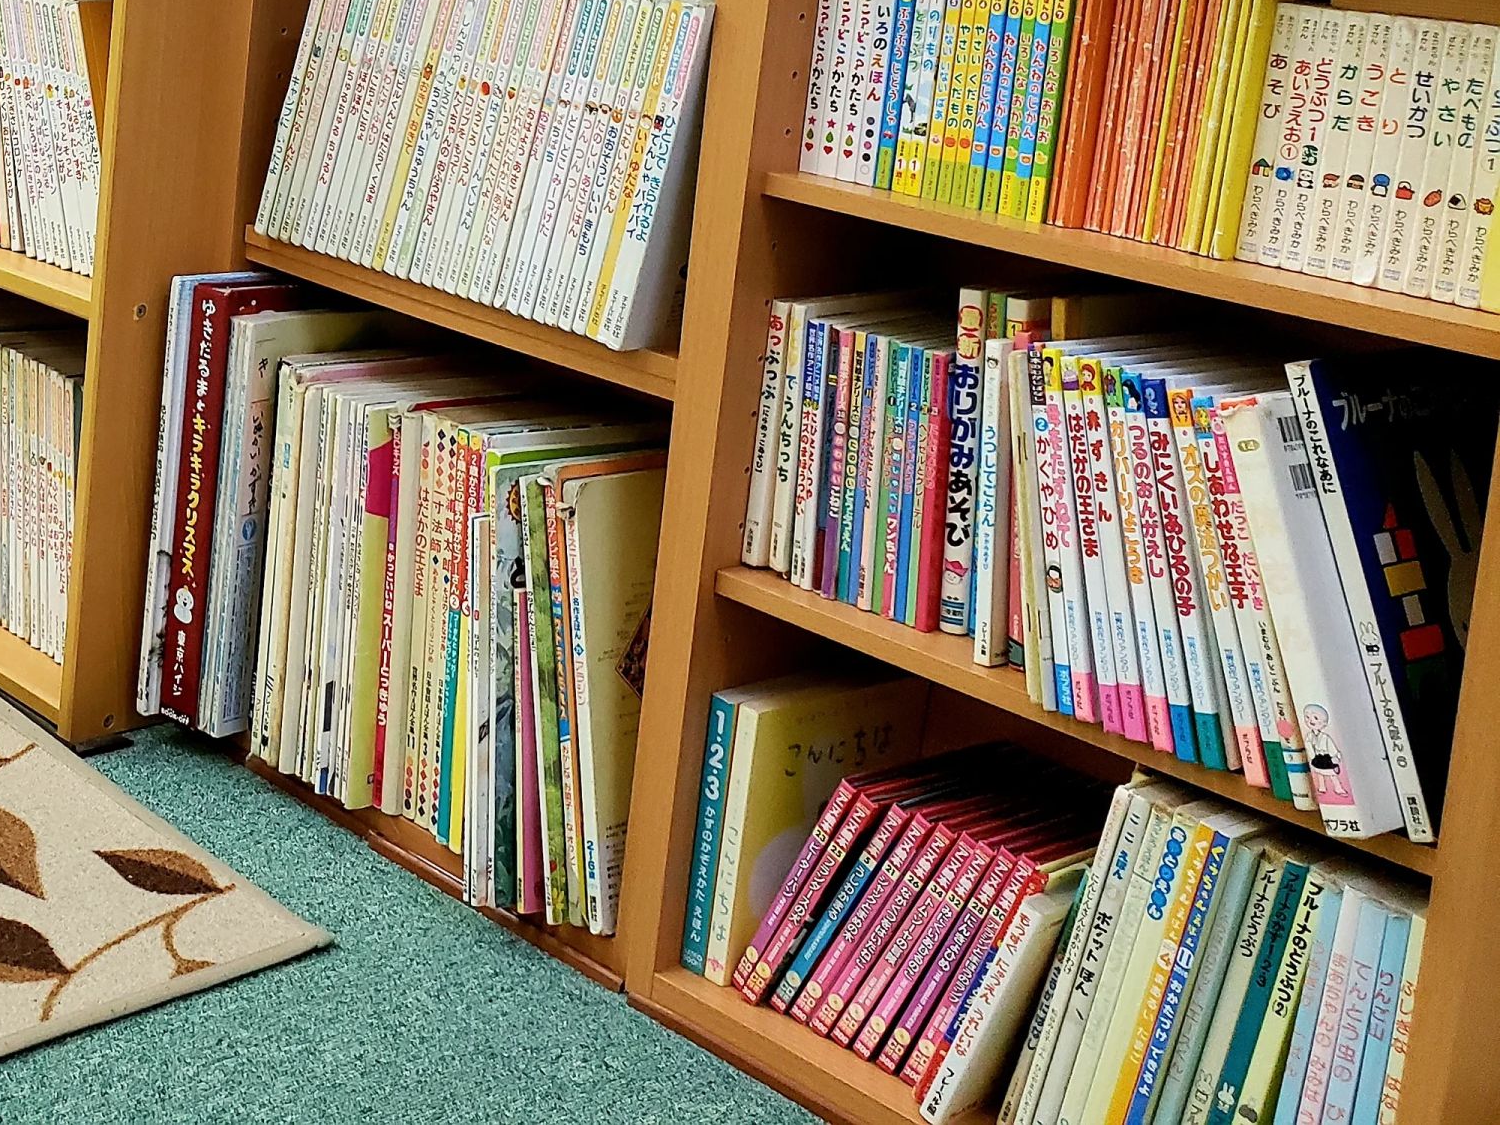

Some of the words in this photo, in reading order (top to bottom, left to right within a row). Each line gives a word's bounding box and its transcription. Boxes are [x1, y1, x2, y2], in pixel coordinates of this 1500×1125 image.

[866, 5, 891, 104] いろのえほん
[922, 9, 941, 72] のりもの
[955, 25, 972, 66] やさい
[970, 25, 986, 66] やさい
[1015, 33, 1032, 89] いろんな
[1045, 37, 1062, 93] いろんな
[946, 72, 964, 131] くだもの
[961, 72, 978, 131] くだもの
[992, 33, 1016, 132] ねんねのじかん
[1007, 95, 1023, 139] おかお
[1022, 39, 1046, 140] ねんねのじかん
[1263, 53, 1288, 119] あそび
[1331, 64, 1359, 133] からだ
[1381, 67, 1408, 135] とり
[1407, 71, 1434, 139] せいかつ
[1434, 78, 1460, 148] やさい
[1457, 78, 1485, 149] たべもの
[6, 85, 22, 177] うさぎさんコロッケ
[1037, 99, 1054, 143] おかお
[760, 314, 784, 400] あっぷっぷ
[944, 362, 982, 547] おりがみあそび
[1085, 410, 1113, 523] 赤ずきん
[1292, 373, 1339, 496] ブルーナのこれなあに
[980, 424, 999, 528] うつしてごらん
[1034, 433, 1059, 550] かぐやひめ
[1066, 412, 1099, 559] はだかの王さま
[1128, 424, 1165, 578] つるのおんがえし
[415, 488, 430, 597] はだかの王さま
[429, 490, 445, 555] 一寸法師
[1148, 429, 1195, 617] みにくいあひるの子
[1181, 442, 1228, 612] オズの魔法つかい
[1203, 451, 1248, 610] しあわせな王子
[784, 725, 895, 777] こんにちは
[1405, 793, 1425, 827] 講談社
[788, 856, 835, 925] フランダースの犬
